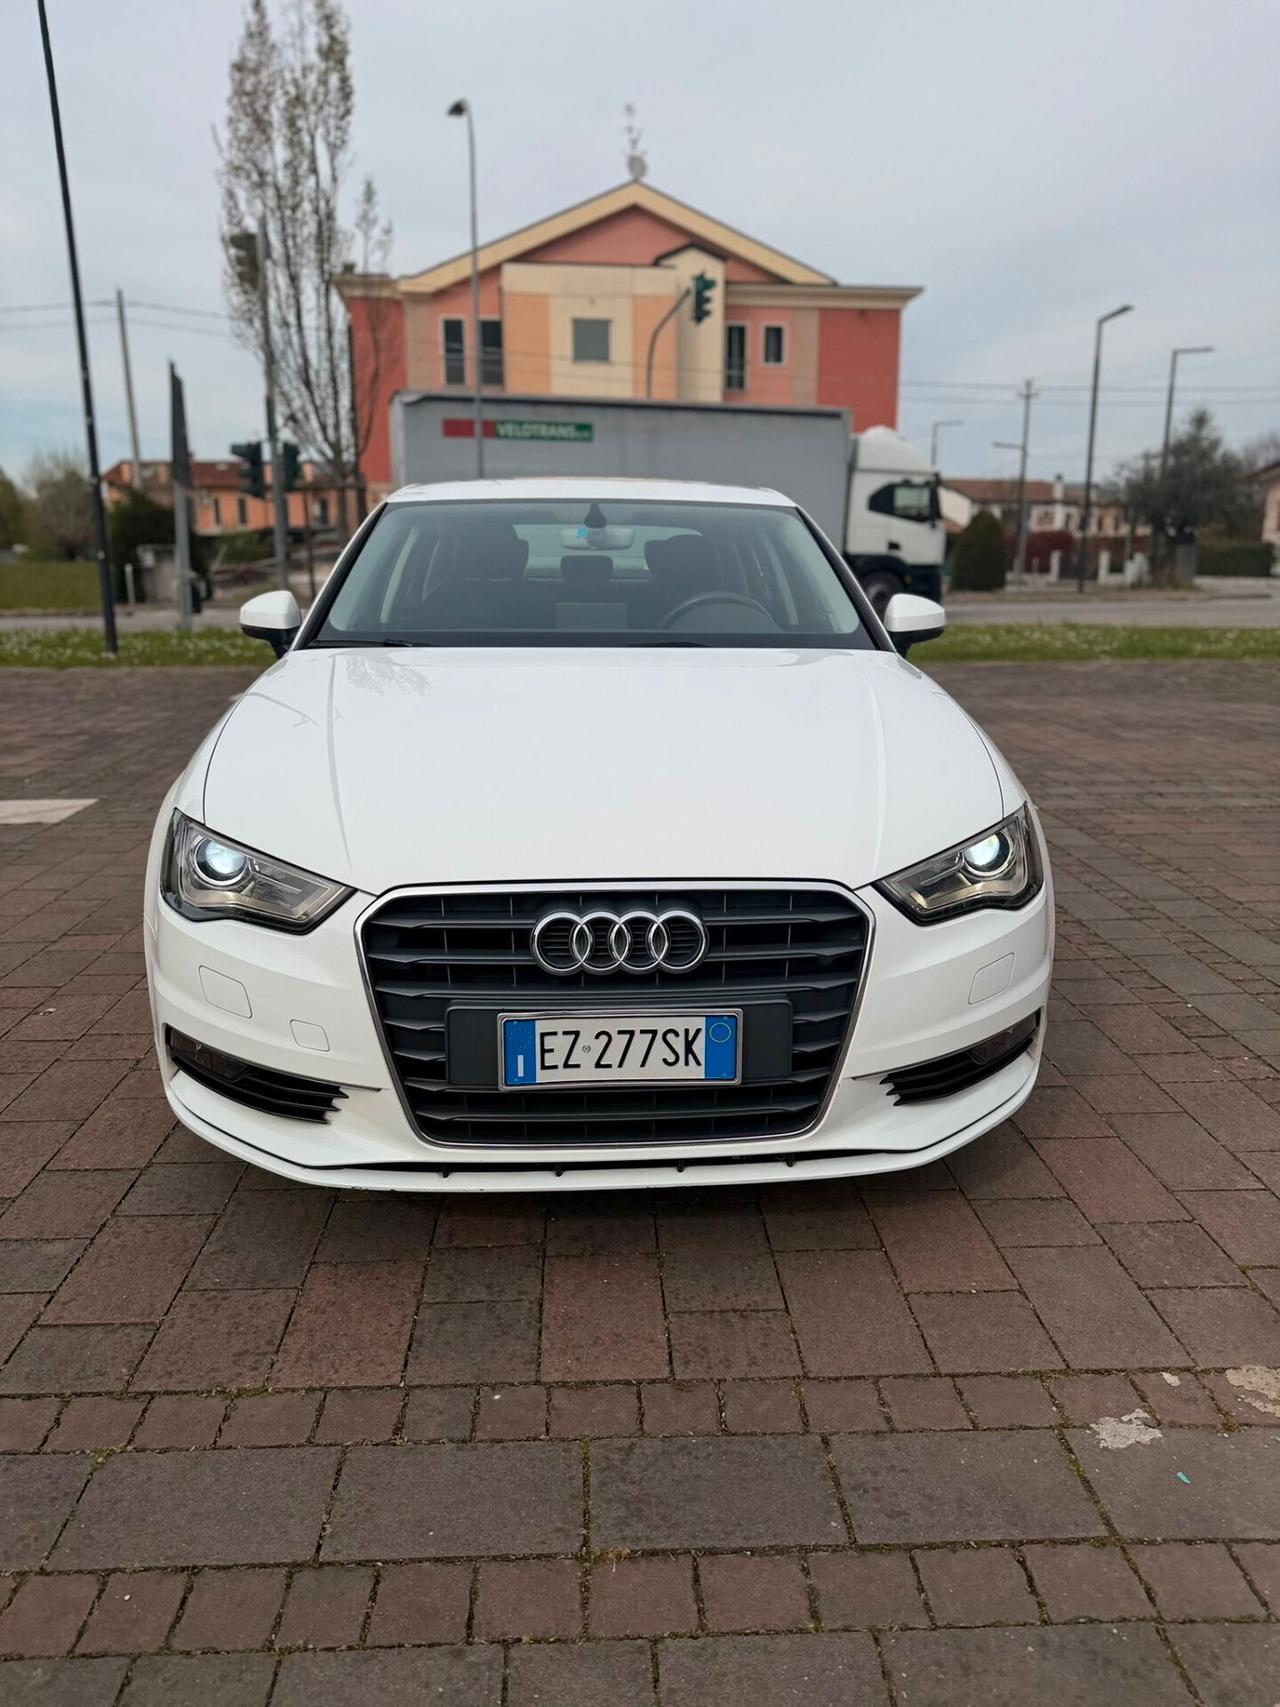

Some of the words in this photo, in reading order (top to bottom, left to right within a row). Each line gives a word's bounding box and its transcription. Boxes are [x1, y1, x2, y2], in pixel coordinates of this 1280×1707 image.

[517, 1054, 525, 1078] I
[539, 1030, 581, 1071] EZ
[593, 1027, 703, 1069] 277SK
